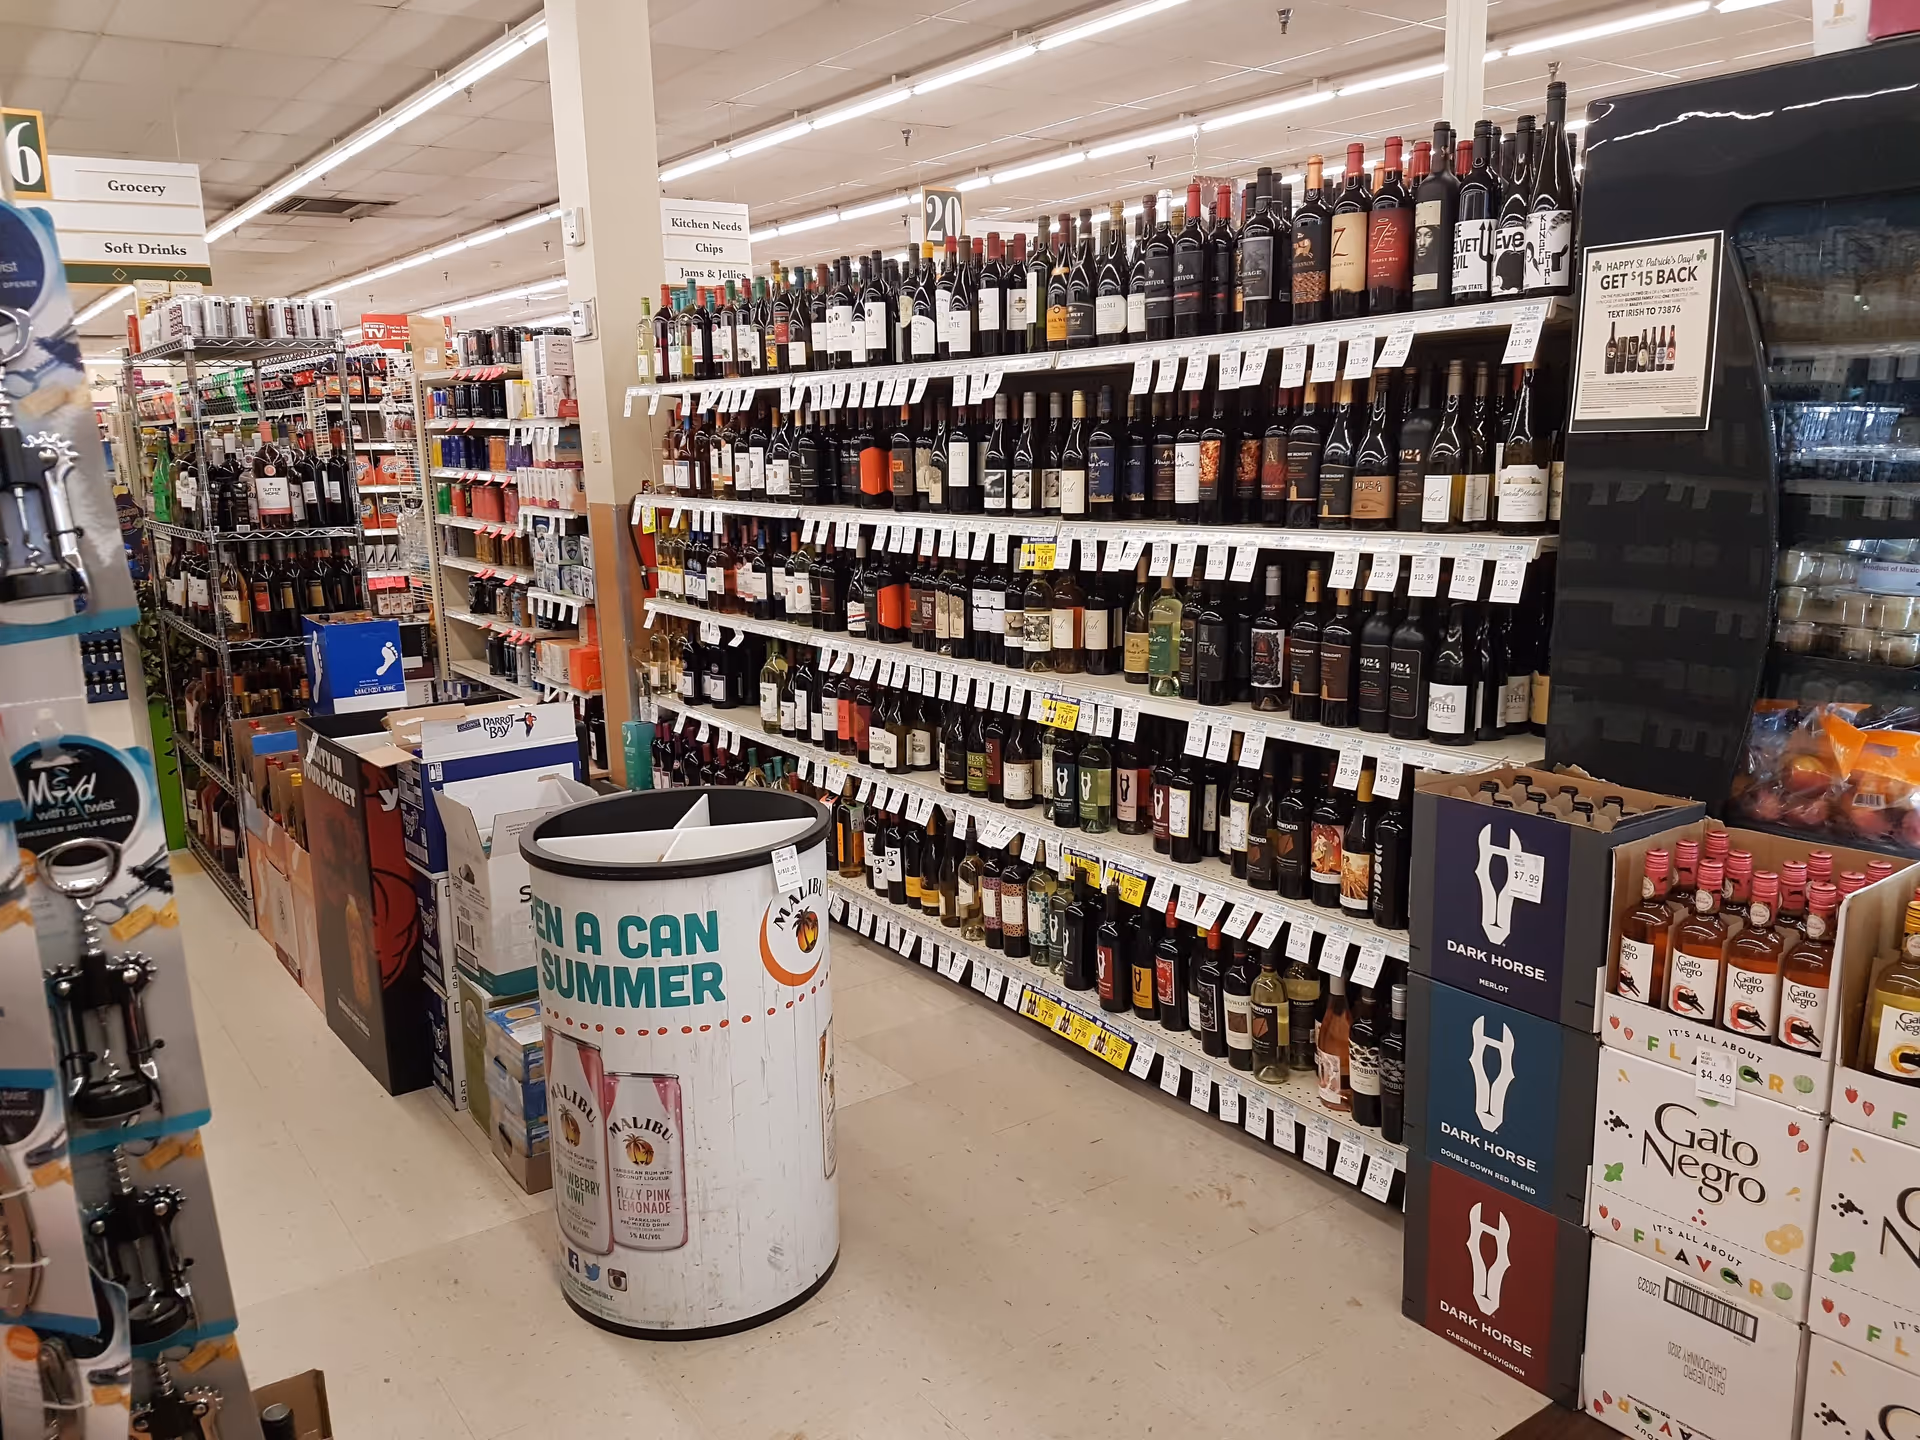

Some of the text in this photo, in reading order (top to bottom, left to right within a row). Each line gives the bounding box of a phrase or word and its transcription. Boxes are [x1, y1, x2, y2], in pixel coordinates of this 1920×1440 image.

[107, 179, 167, 197] Grocery
[671, 217, 742, 233] Kitchen Needs
[925, 195, 962, 241] 20
[695, 242, 724, 256] Chips
[1496, 231, 1524, 250] Eve
[104, 242, 188, 257] Soft Drinks
[680, 267, 747, 281] Jams & Jellies
[1606, 260, 1635, 271] HAPPY
[1600, 265, 1698, 290] GET $15 BACK
[1468, 283, 1483, 291] STATE
[1608, 305, 1681, 319] TEXT IRISH TO 73876
[365, 329, 384, 338] TV
[1510, 338, 1533, 347] $11.99
[1221, 366, 1238, 376] $9.99
[1863, 562, 1888, 573] Product
[1890, 564, 1899, 572] of
[1497, 579, 1519, 588] $10.99
[483, 713, 516, 730] PARROT
[489, 725, 511, 740] BAY
[1339, 767, 1358, 778] $9.99
[1379, 774, 1400, 786] $9.99
[321, 773, 356, 808] POCKET
[36, 799, 116, 821] with a twist
[17, 826, 65, 840] ORKSCREW
[1514, 870, 1540, 885] $7.99
[772, 877, 825, 931] MALIBU
[575, 911, 602, 956] A
[617, 909, 720, 960] CAN
[1446, 939, 1547, 982] DARK HORSE
[1620, 949, 1639, 961] egro
[1677, 954, 1701, 970] Gato
[541, 947, 727, 1009] SUMMER
[1675, 961, 1703, 978] Negro
[1479, 978, 1509, 994] MERLOT
[1732, 978, 1764, 995] Negro
[1735, 971, 1763, 986] Gato
[1787, 992, 1818, 1009] Negro
[1789, 984, 1817, 1000] Gato
[1895, 1020, 1920, 1037] Neg
[1668, 1028, 1690, 1039] IT'S
[1695, 1032, 1717, 1045] ALL
[1721, 1039, 1763, 1064] ABOUT
[1700, 1069, 1732, 1085] $4.49
[551, 1083, 597, 1124] MALIBU
[608, 1115, 674, 1143] MALIBU
[1653, 1101, 1760, 1169] Gato
[1440, 1121, 1536, 1173] DARK HORSE
[1339, 1157, 1359, 1169] $6.99
[1640, 1128, 1768, 1205] Negro
[1368, 1173, 1388, 1187] $6.99
[1440, 1148, 1536, 1196] DOUBLE DOWN RED BLEND
[616, 1186, 671, 1201] FIZZY PINK
[618, 1199, 671, 1214] LEMONADE
[1653, 1223, 1743, 1267] IT'S ALL ABOUT
[1638, 1276, 1661, 1299] L20323
[1439, 1299, 1533, 1360] DARK HORSE
[1445, 1328, 1526, 1377] CABERNET SAUVIGNON
[1667, 1341, 1728, 1381] CHARDONNAY 2020
[1683, 1364, 1726, 1396] GATO NEGRO
